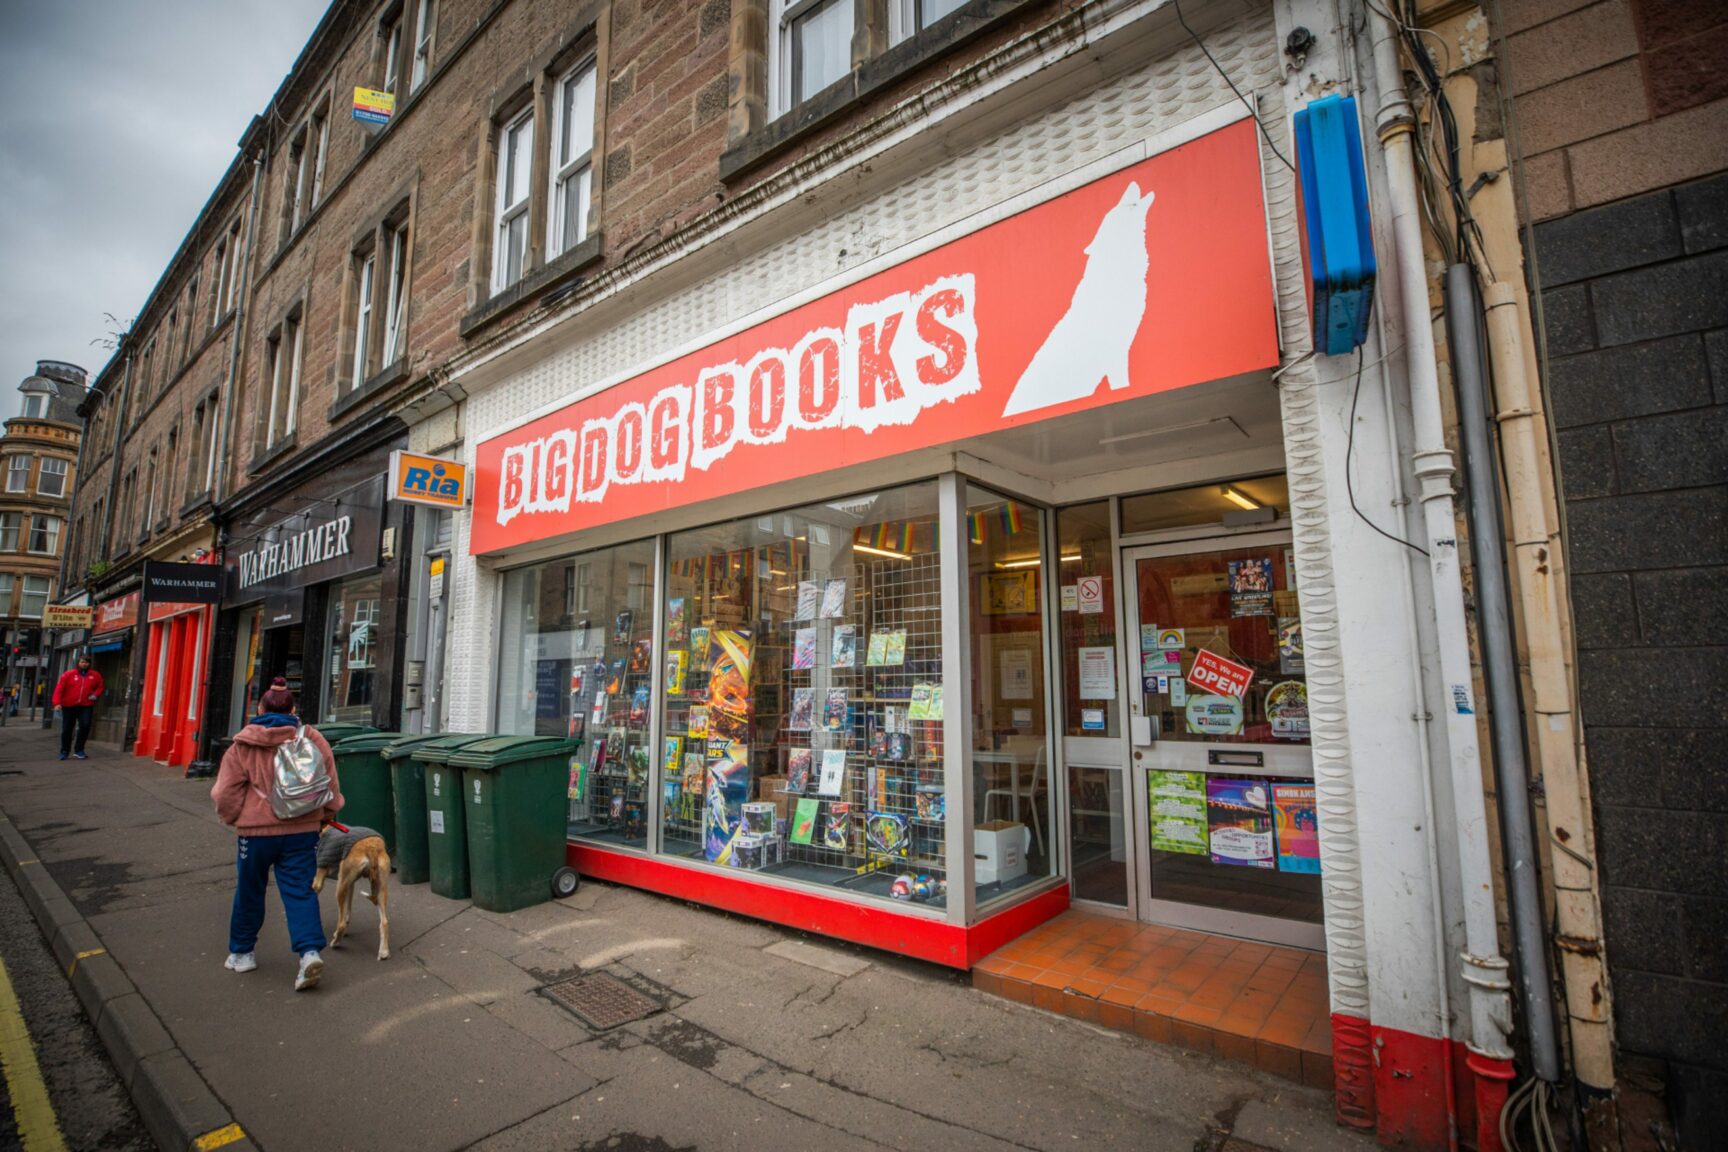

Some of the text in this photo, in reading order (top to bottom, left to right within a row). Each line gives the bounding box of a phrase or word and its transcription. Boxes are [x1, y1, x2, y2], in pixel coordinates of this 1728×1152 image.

[500, 284, 970, 515] BIG DOG BOOKS
[403, 464, 460, 496] Ria
[239, 515, 351, 590] WARHAMMER
[151, 577, 216, 588] WARHAMMER
[1193, 666, 1243, 697] OPEN
[1201, 657, 1218, 670] YES,
[1219, 665, 1231, 675] We
[1231, 671, 1245, 682] are
